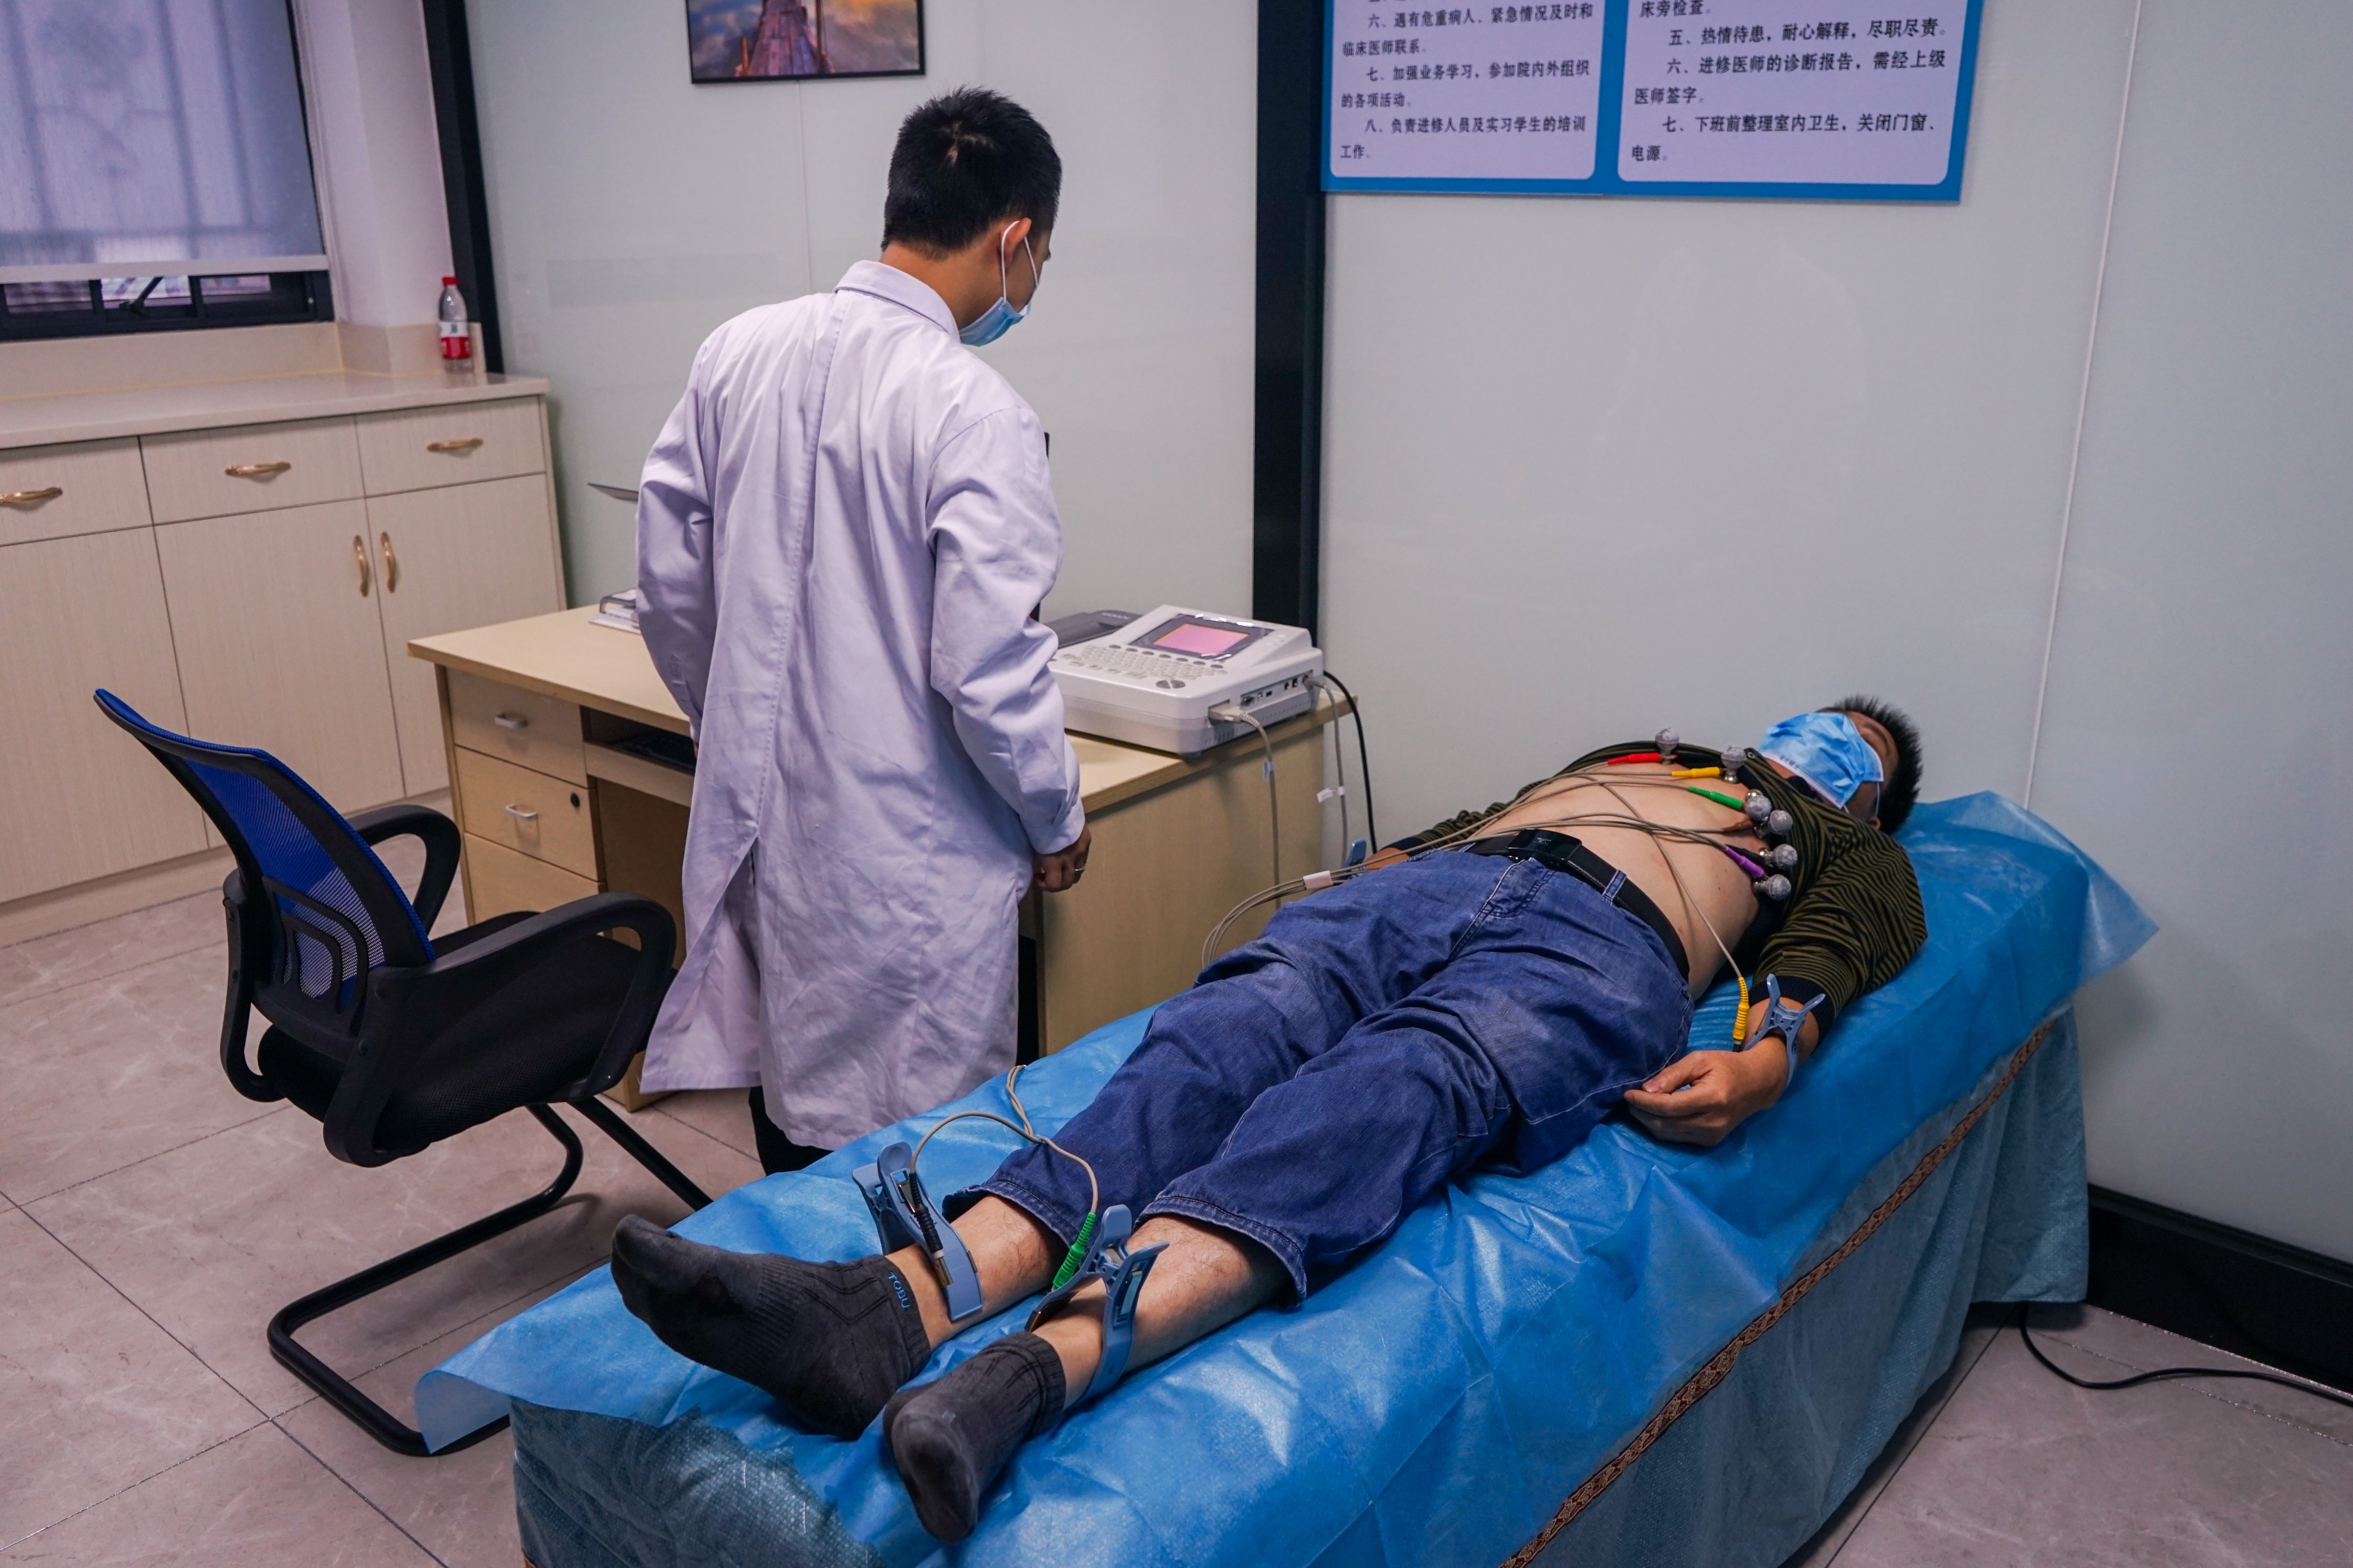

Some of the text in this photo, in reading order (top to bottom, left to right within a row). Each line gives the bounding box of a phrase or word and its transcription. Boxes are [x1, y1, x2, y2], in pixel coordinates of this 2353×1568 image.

[1634, 87, 1704, 104] 医师签字。
[1631, 145, 1668, 161] 电源。
